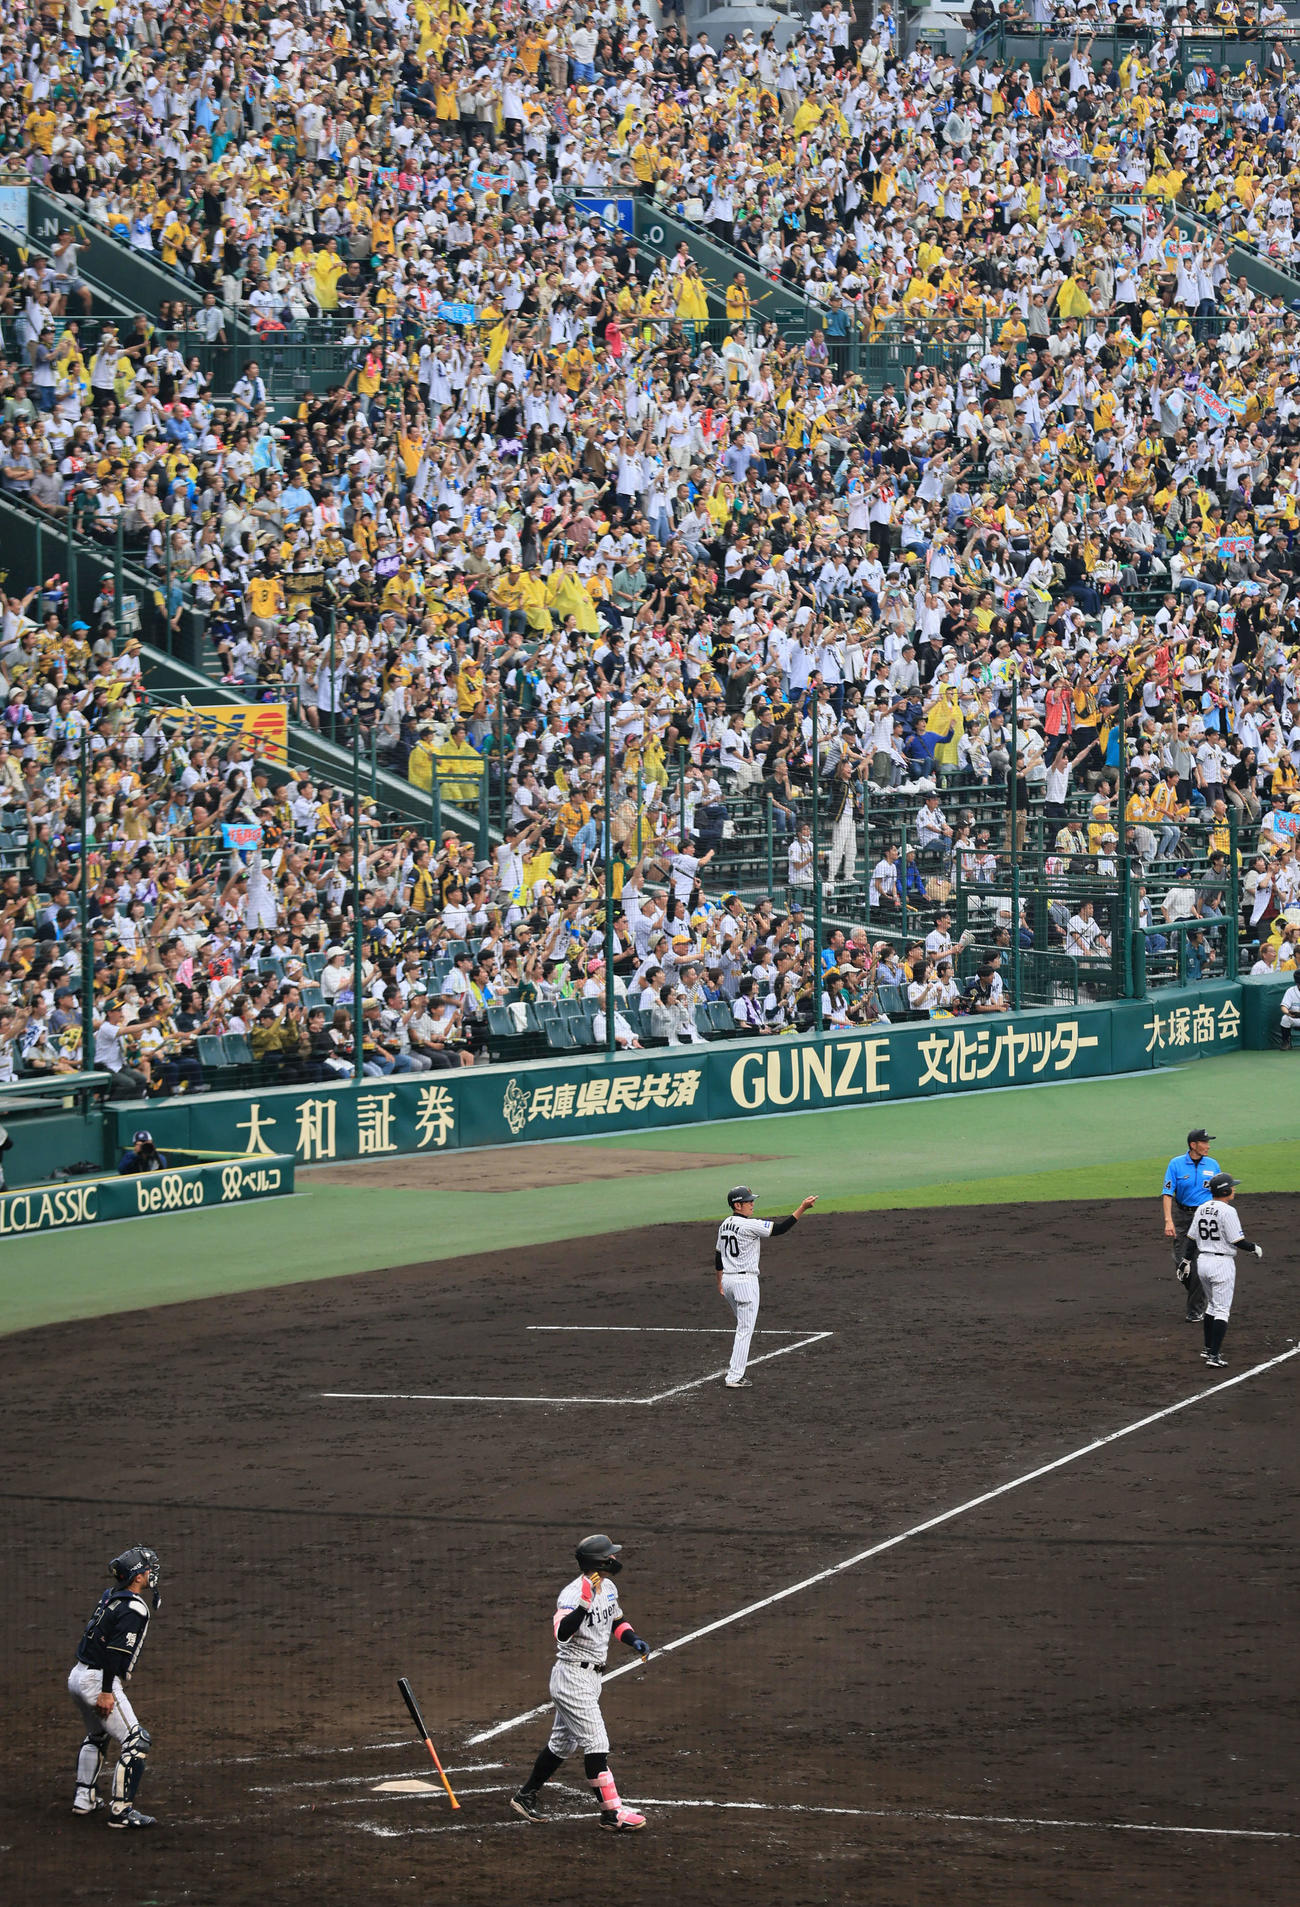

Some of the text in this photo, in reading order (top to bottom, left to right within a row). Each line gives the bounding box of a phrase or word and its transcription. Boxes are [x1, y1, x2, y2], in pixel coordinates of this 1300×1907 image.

[1143, 1000, 1240, 1052] 大塚商会
[527, 1069, 702, 1122] 兵庫県民共済
[730, 1038, 891, 1109] GUNZE
[236, 1086, 455, 1161] 大和証券
[242, 1168, 281, 1192] ベルコ
[720, 1235, 740, 1258] 70
[1198, 1218, 1221, 1241] 62
